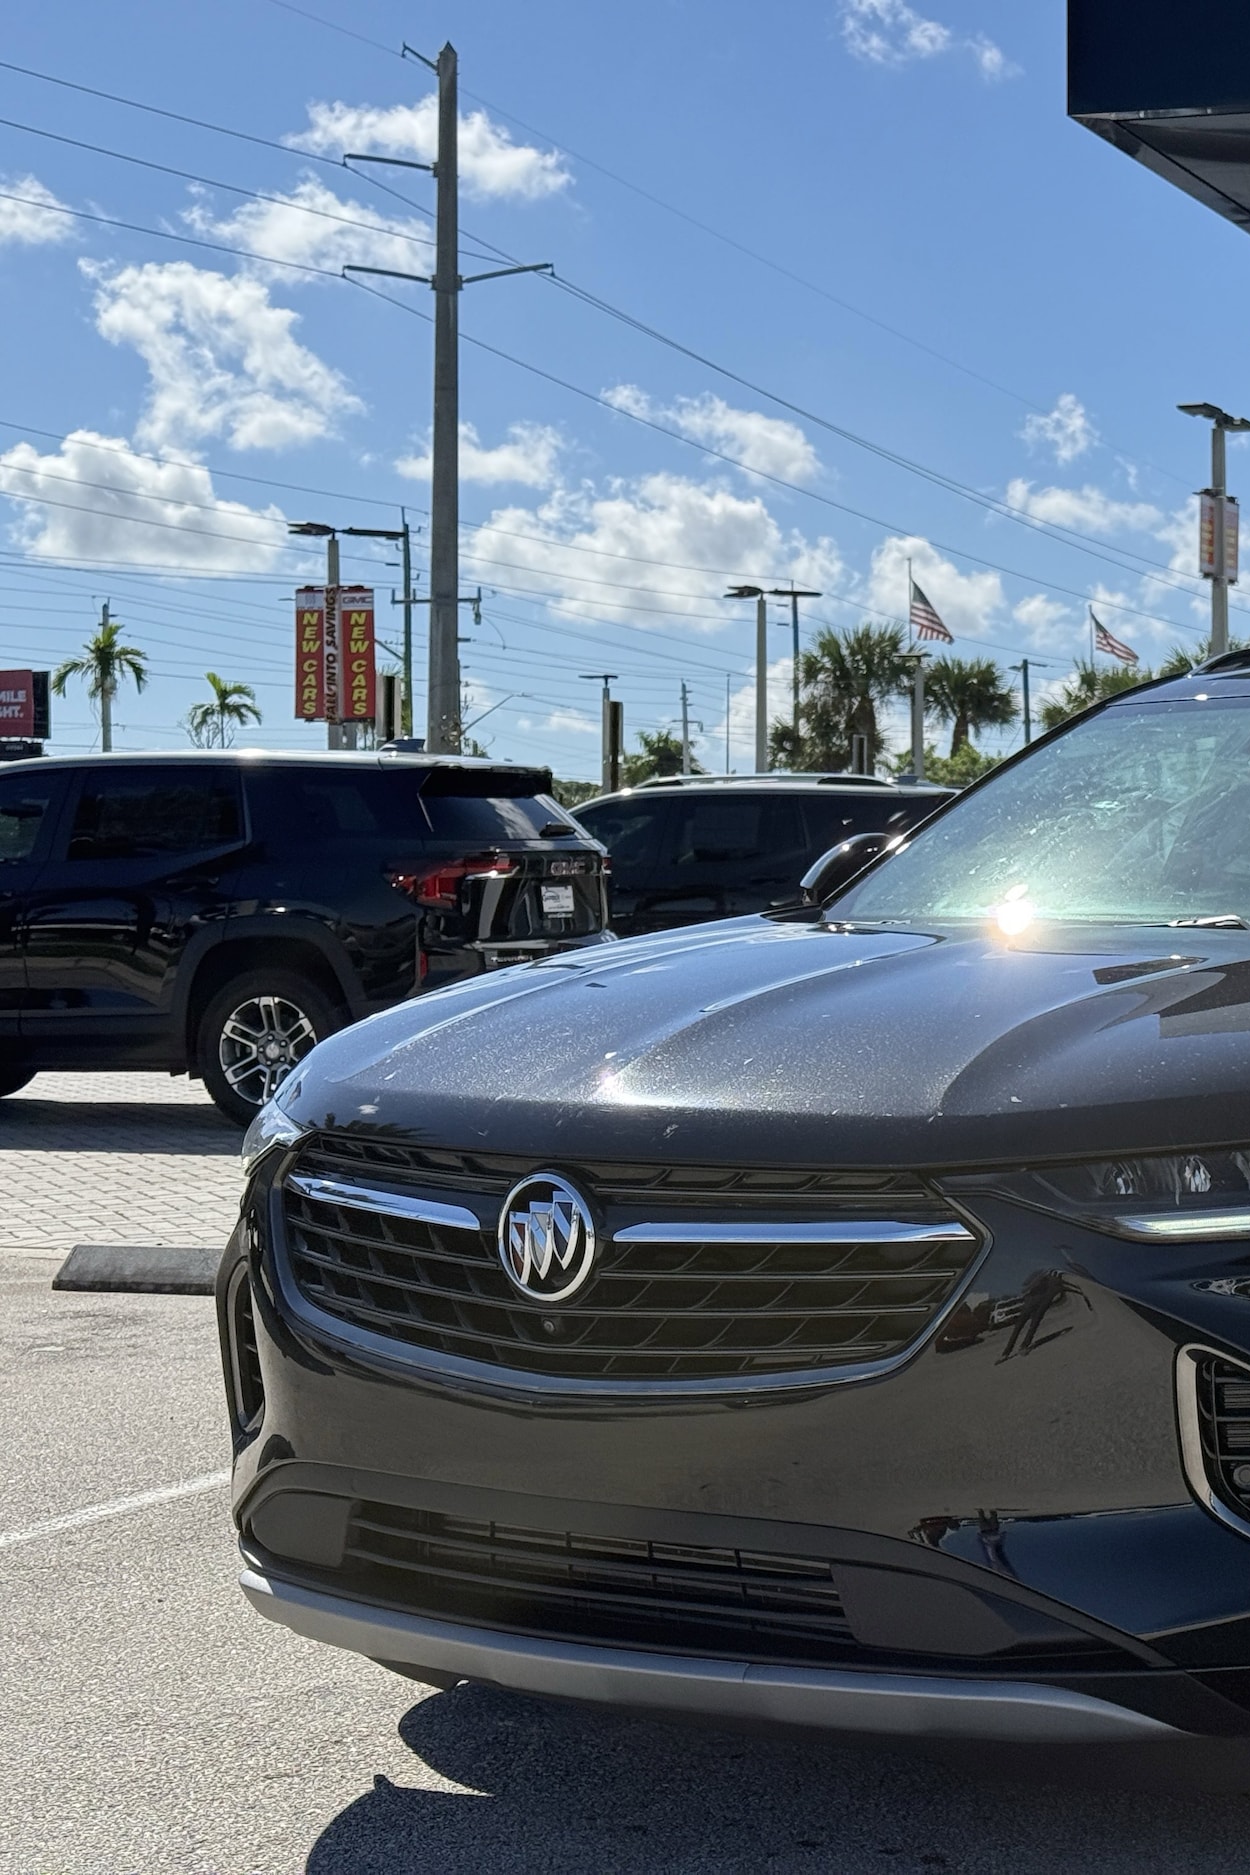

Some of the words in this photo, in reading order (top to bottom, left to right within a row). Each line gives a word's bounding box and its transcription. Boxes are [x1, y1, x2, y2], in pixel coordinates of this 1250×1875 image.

[326, 587, 338, 647] SAVINGS
[343, 596, 372, 605] GMC
[302, 612, 321, 653] NEW
[350, 612, 369, 653] NEW
[302, 659, 318, 715] CARS
[326, 652, 338, 686] INTO
[351, 659, 369, 715] CARS
[326, 691, 338, 722] FALL
